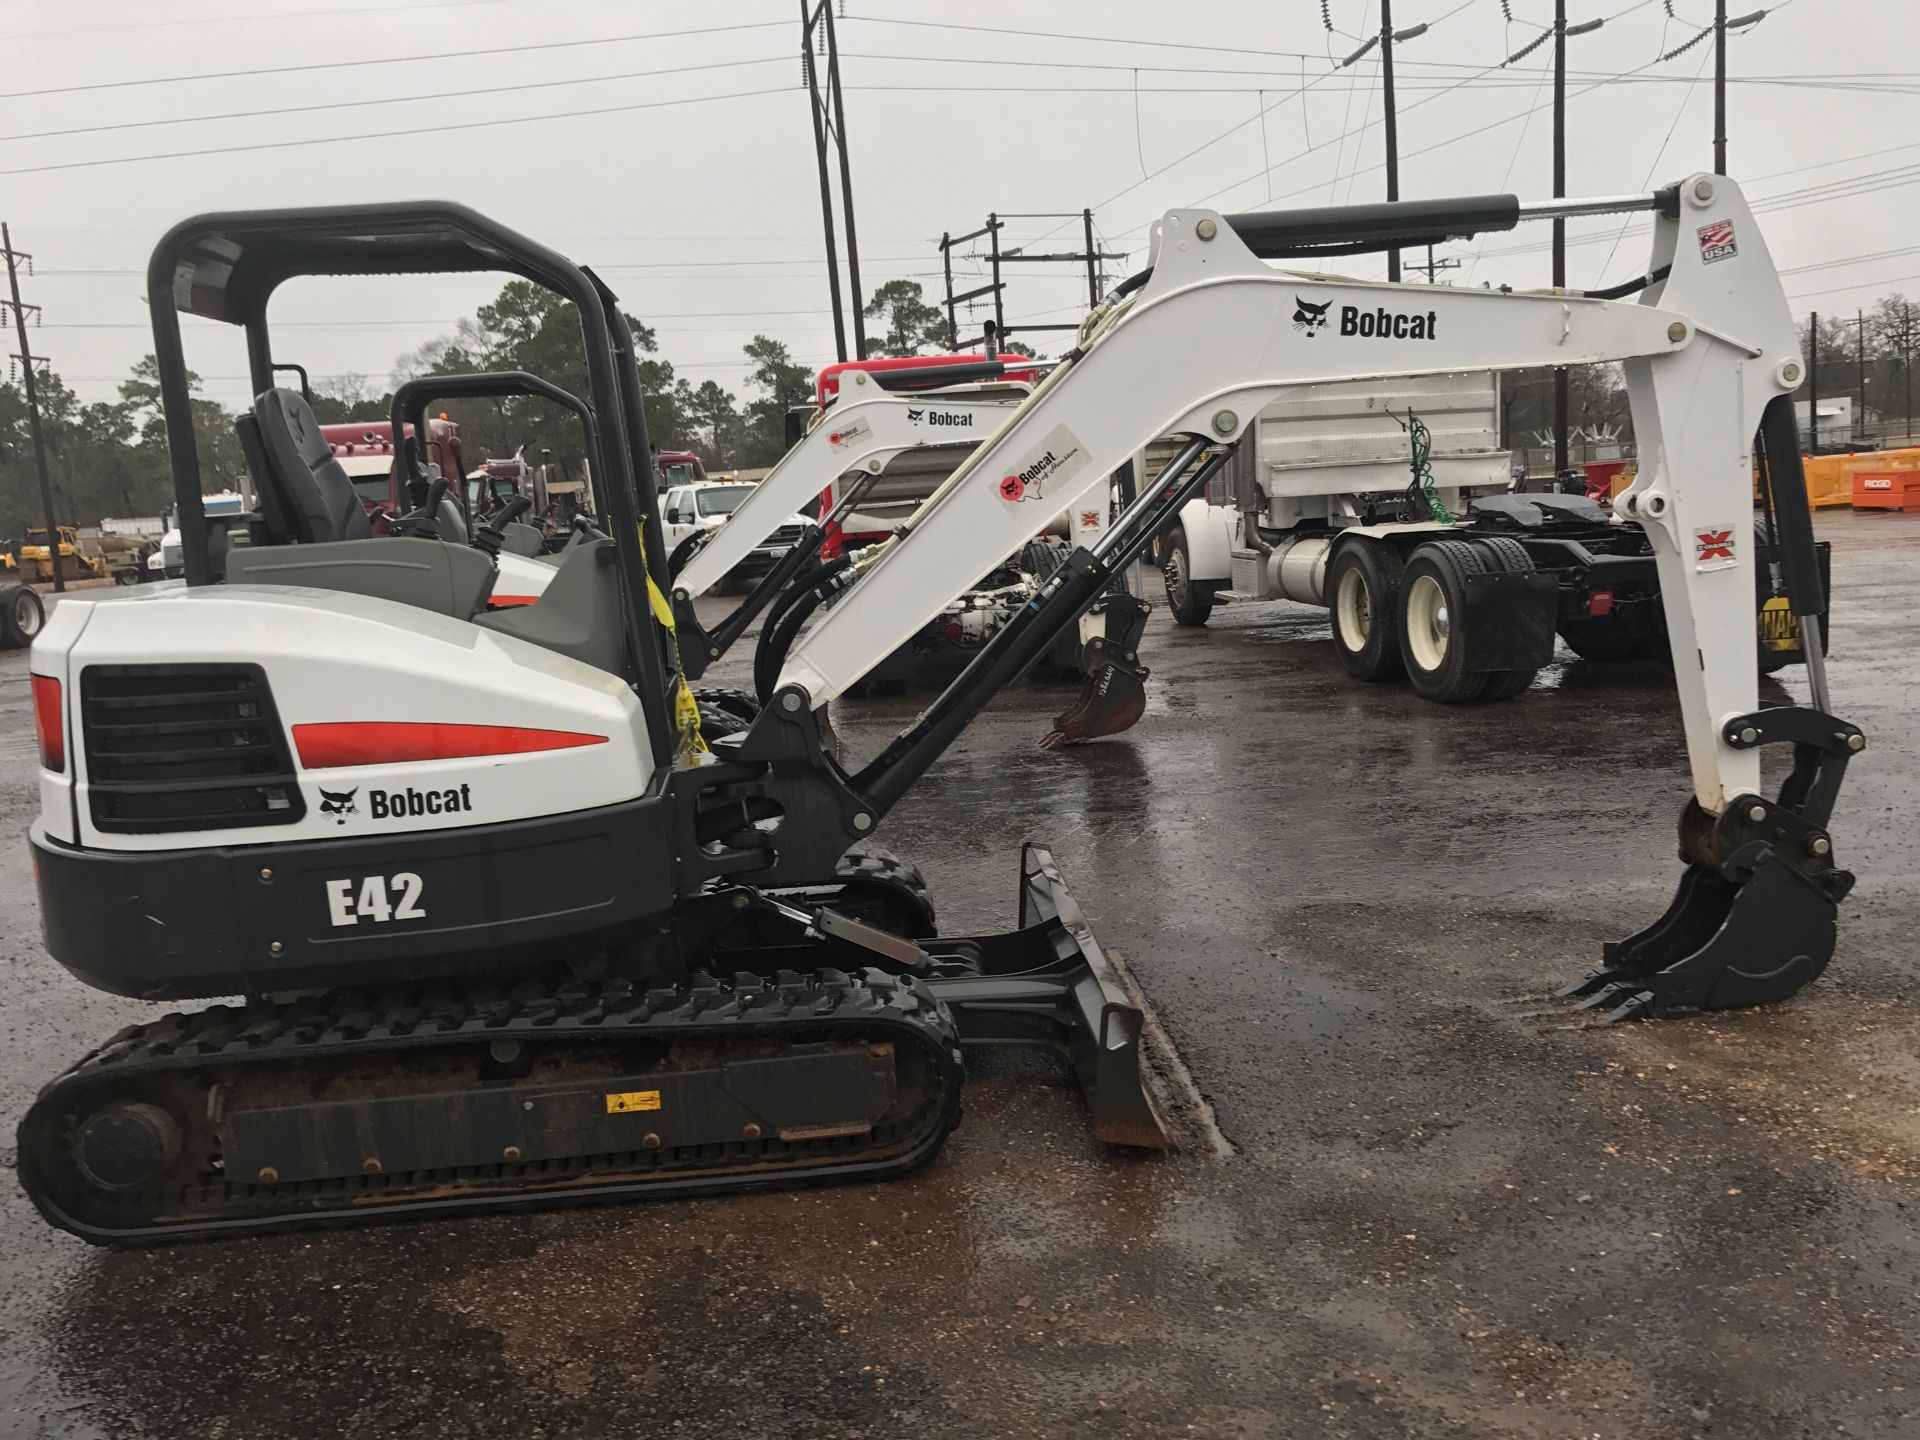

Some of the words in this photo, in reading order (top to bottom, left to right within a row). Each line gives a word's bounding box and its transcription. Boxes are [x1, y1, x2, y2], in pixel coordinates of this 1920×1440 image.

[1704, 245, 1734, 259] USA
[1341, 306, 1436, 340] Bobcat
[929, 411, 973, 427] Bobcat
[1019, 451, 1056, 485] Bobcat
[1864, 479, 1892, 488] RIDGID
[370, 784, 471, 819] Bobcat
[327, 873, 425, 926] E42
